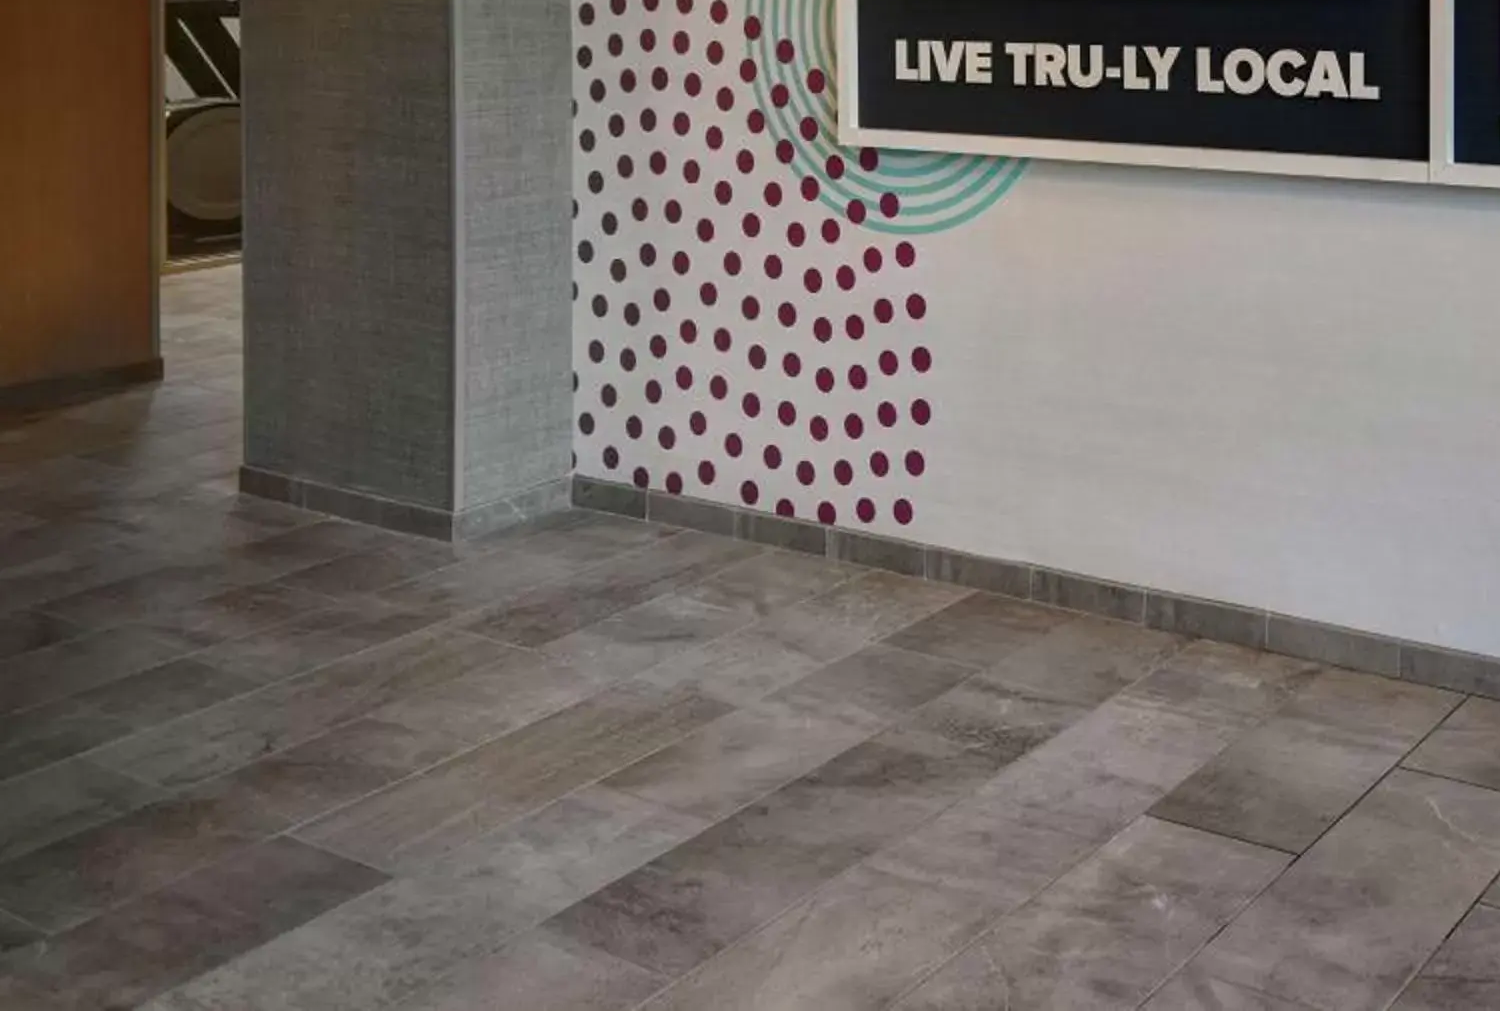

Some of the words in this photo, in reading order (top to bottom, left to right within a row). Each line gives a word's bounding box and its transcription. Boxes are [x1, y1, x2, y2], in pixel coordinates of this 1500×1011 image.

[896, 39, 993, 84] LIVE
[1005, 42, 1181, 91] TRU-LY
[1196, 47, 1381, 101] LOCAL
